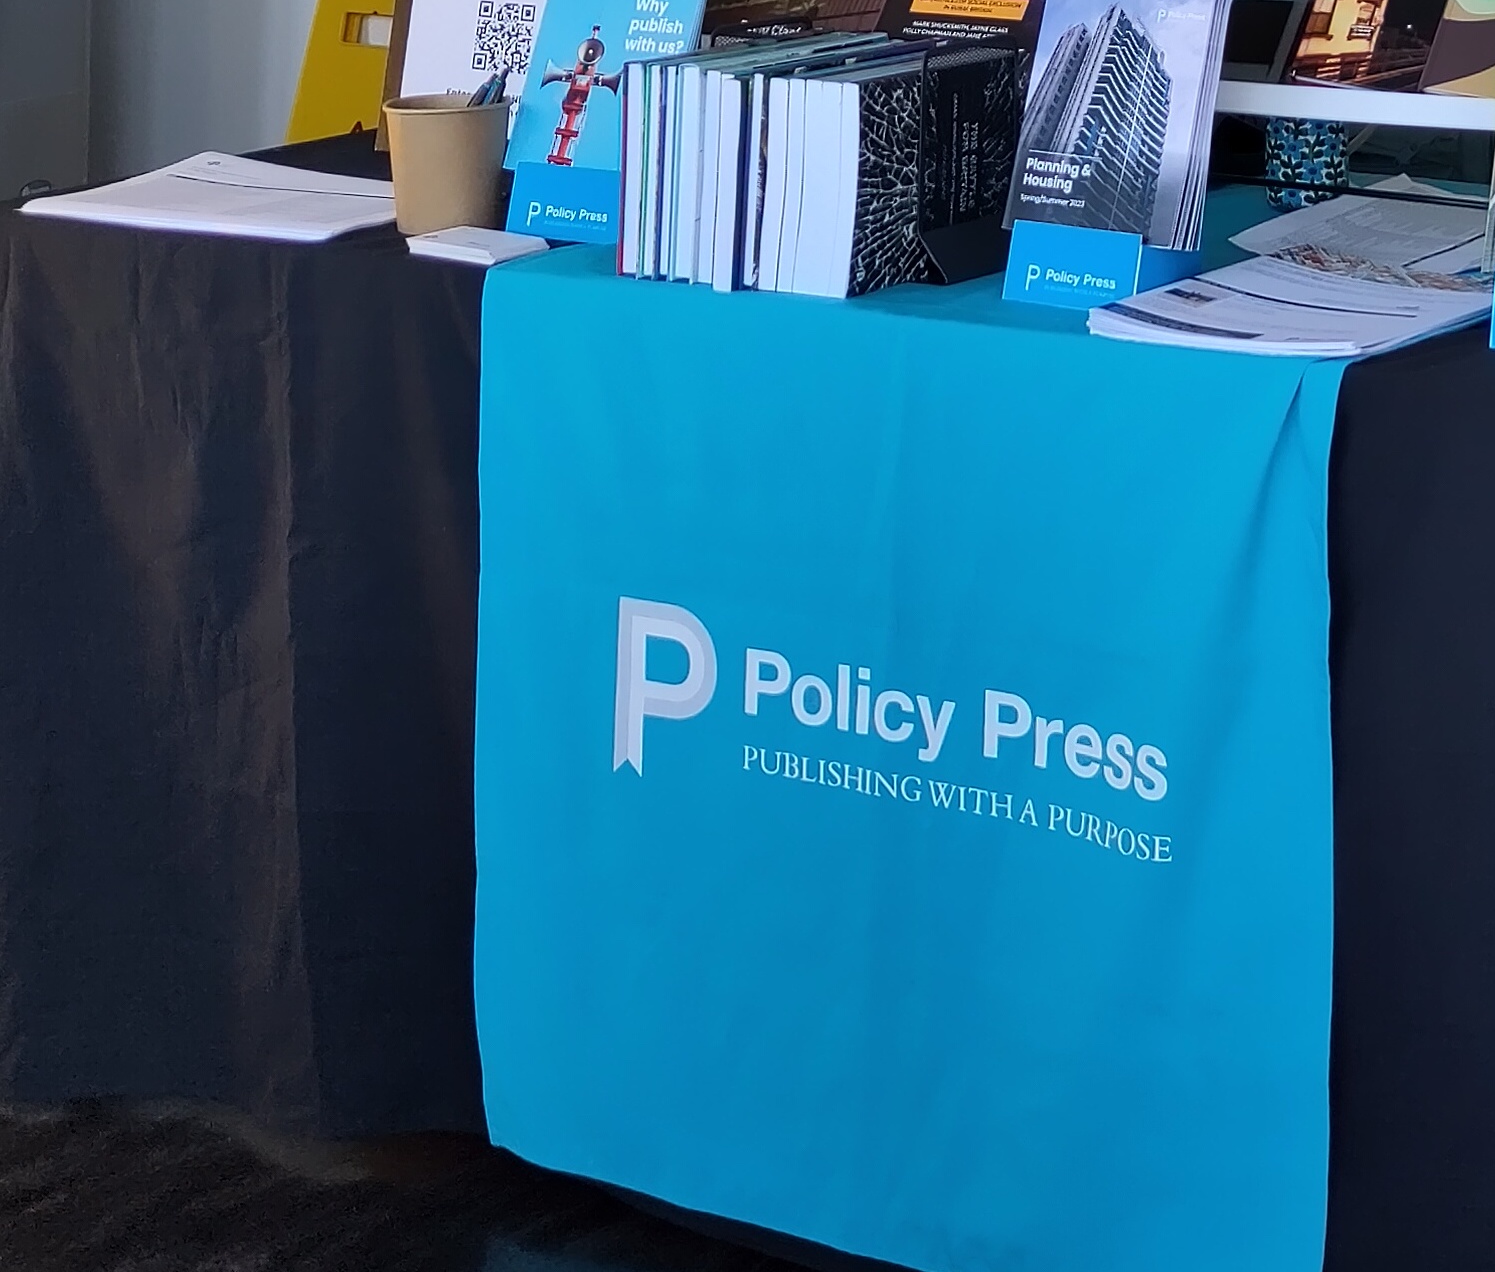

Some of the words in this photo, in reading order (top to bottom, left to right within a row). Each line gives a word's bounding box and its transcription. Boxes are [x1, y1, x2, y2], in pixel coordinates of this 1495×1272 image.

[628, 17, 684, 36] publish
[625, 36, 656, 53] with
[658, 41, 684, 55] us?
[1026, 157, 1079, 177] Planning
[1081, 164, 1092, 176] &
[1023, 173, 1073, 193] Housing
[545, 205, 577, 223] Policy
[578, 208, 608, 223] Press
[1045, 269, 1081, 287] Policy
[1082, 273, 1116, 290] Press
[745, 648, 955, 762] Policy
[983, 689, 1168, 801] Press
[743, 745, 922, 803] PUBLISHING
[929, 780, 1012, 820] WITH
[1019, 801, 1038, 826] A
[1048, 803, 1172, 862] PURPOSE
